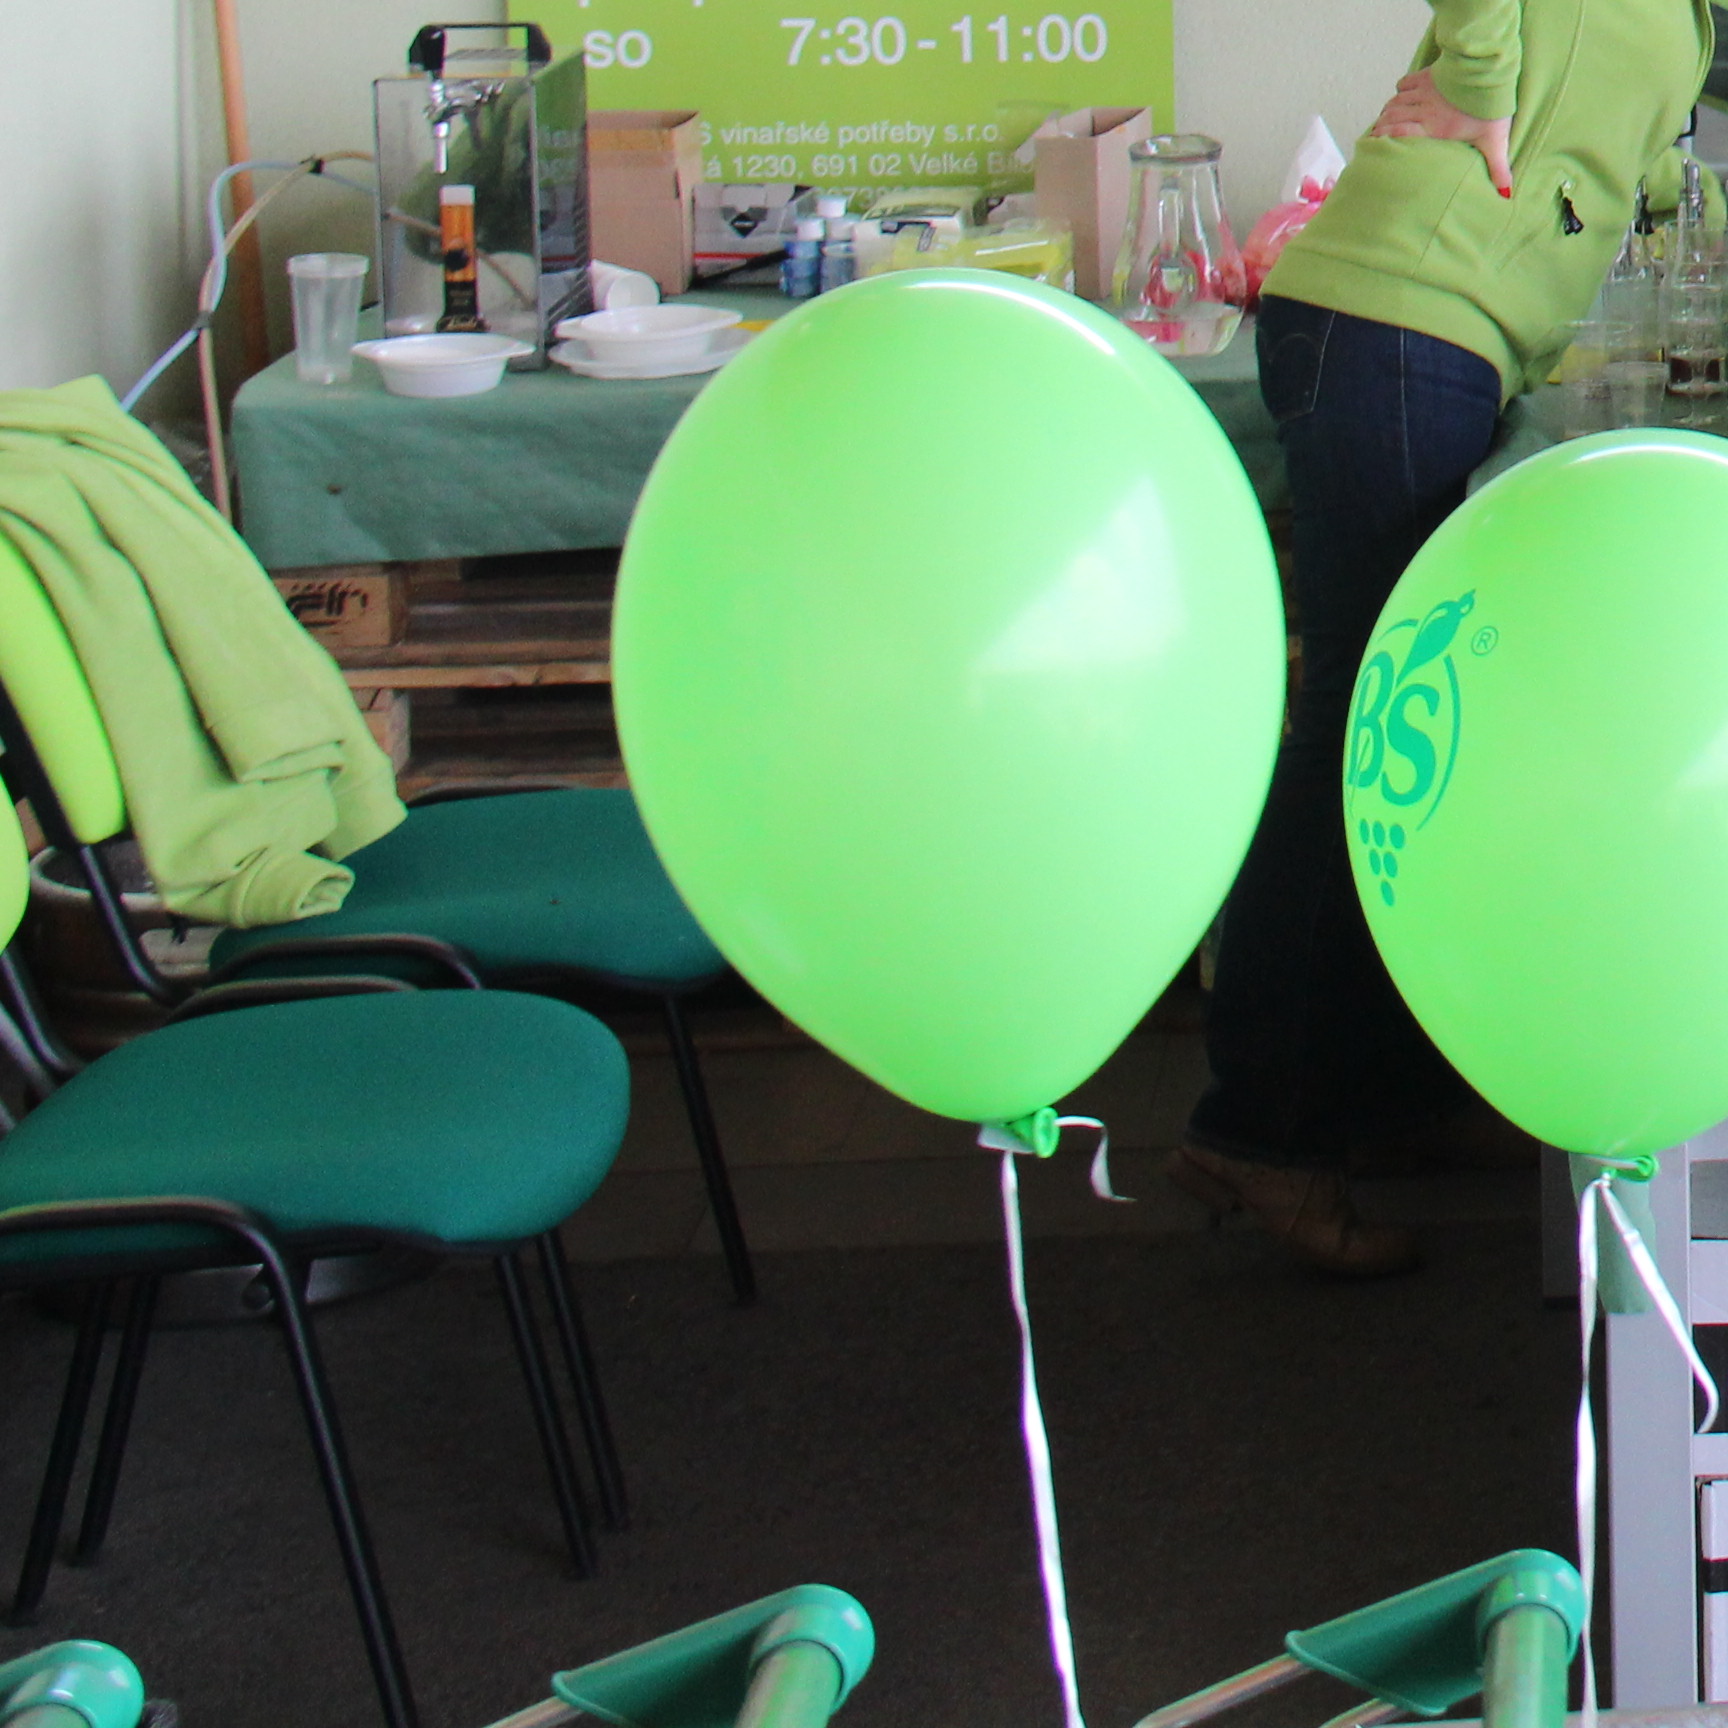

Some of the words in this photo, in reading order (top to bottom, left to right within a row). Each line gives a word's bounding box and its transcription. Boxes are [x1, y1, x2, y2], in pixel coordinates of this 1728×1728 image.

[583, 27, 653, 69] so
[721, 122, 829, 146] vinařské
[838, 120, 935, 149] potřeby
[811, 153, 859, 176] 691
[869, 153, 902, 176] 02
[908, 150, 977, 175] Velké
[1346, 650, 1441, 806] BS
